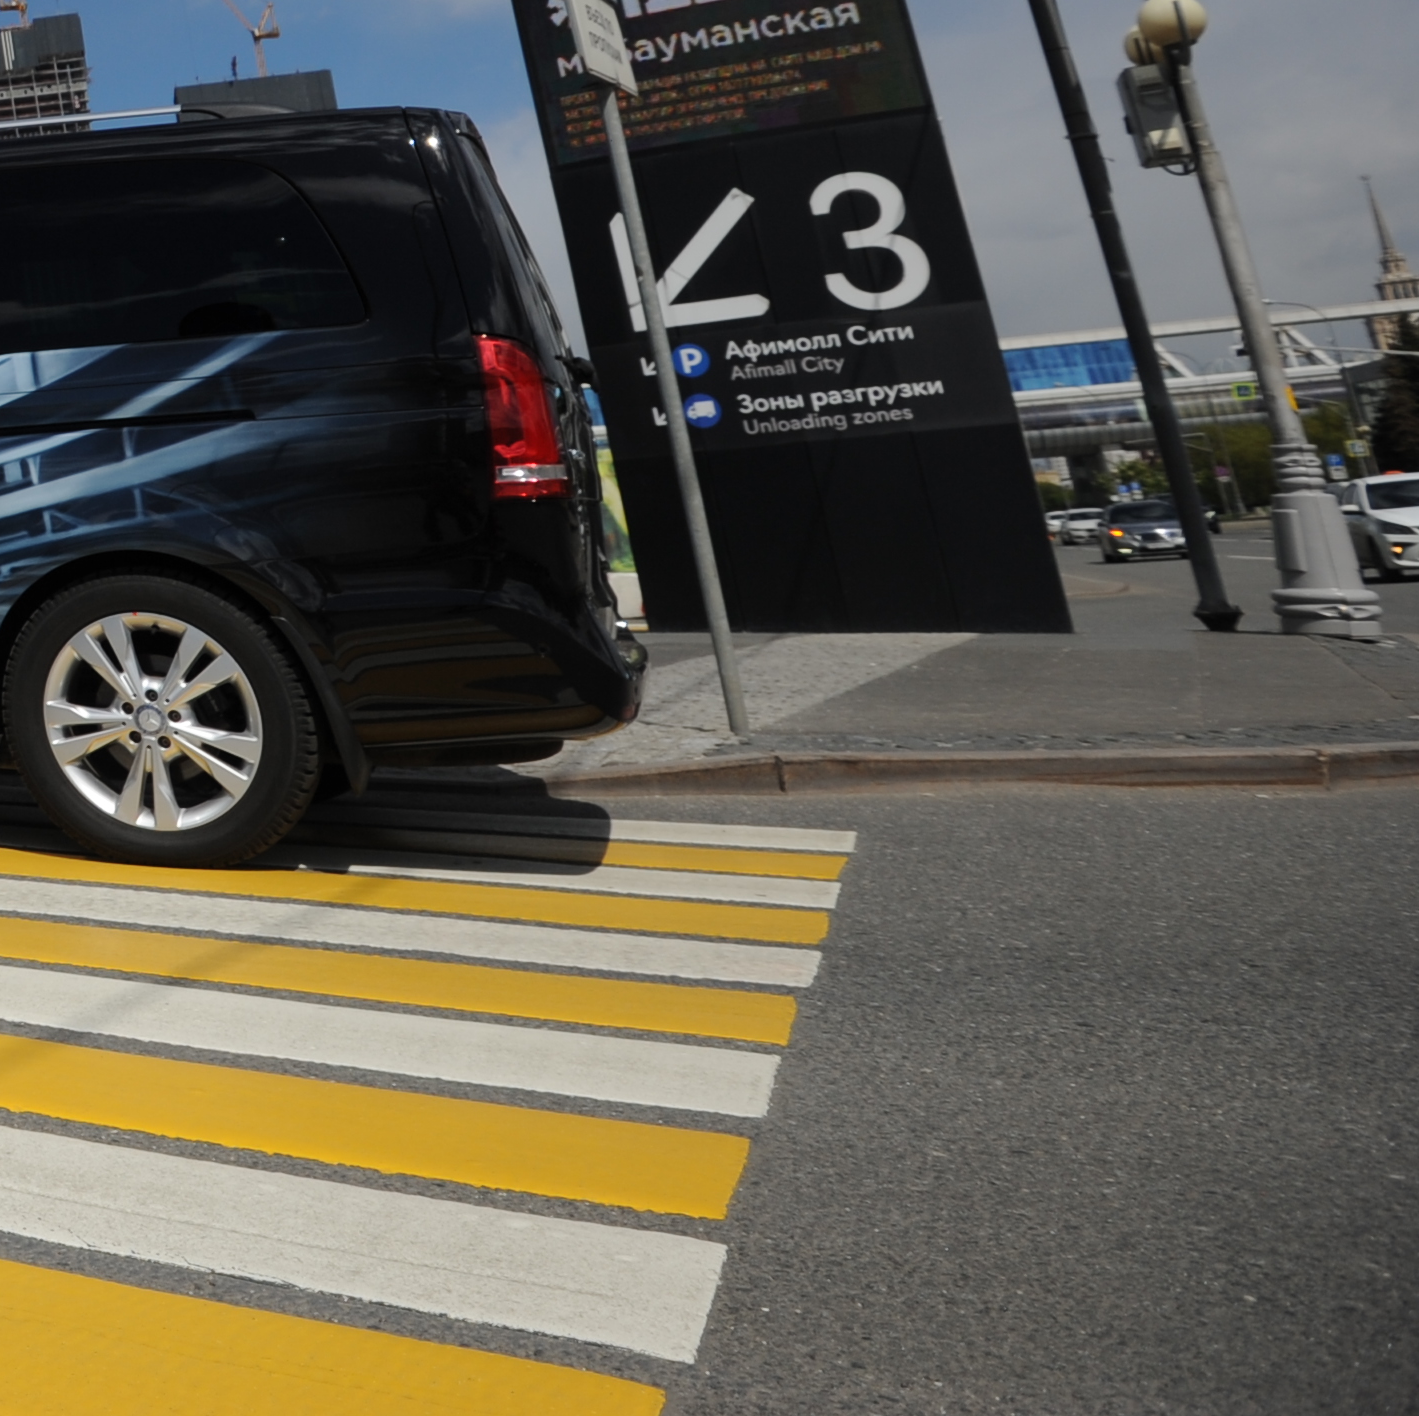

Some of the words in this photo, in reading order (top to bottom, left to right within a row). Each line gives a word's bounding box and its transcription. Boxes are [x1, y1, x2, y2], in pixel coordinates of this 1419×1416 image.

[626, 1, 861, 63] ауманская
[809, 171, 931, 310] 3
[725, 332, 841, 362] Афимолл
[847, 324, 915, 347] Сити
[731, 359, 797, 381] Afimall
[801, 355, 845, 375] City
[737, 391, 805, 415] Зоны
[812, 379, 945, 412] разгрузки
[743, 412, 848, 436] Unloading
[852, 405, 914, 425] zones
